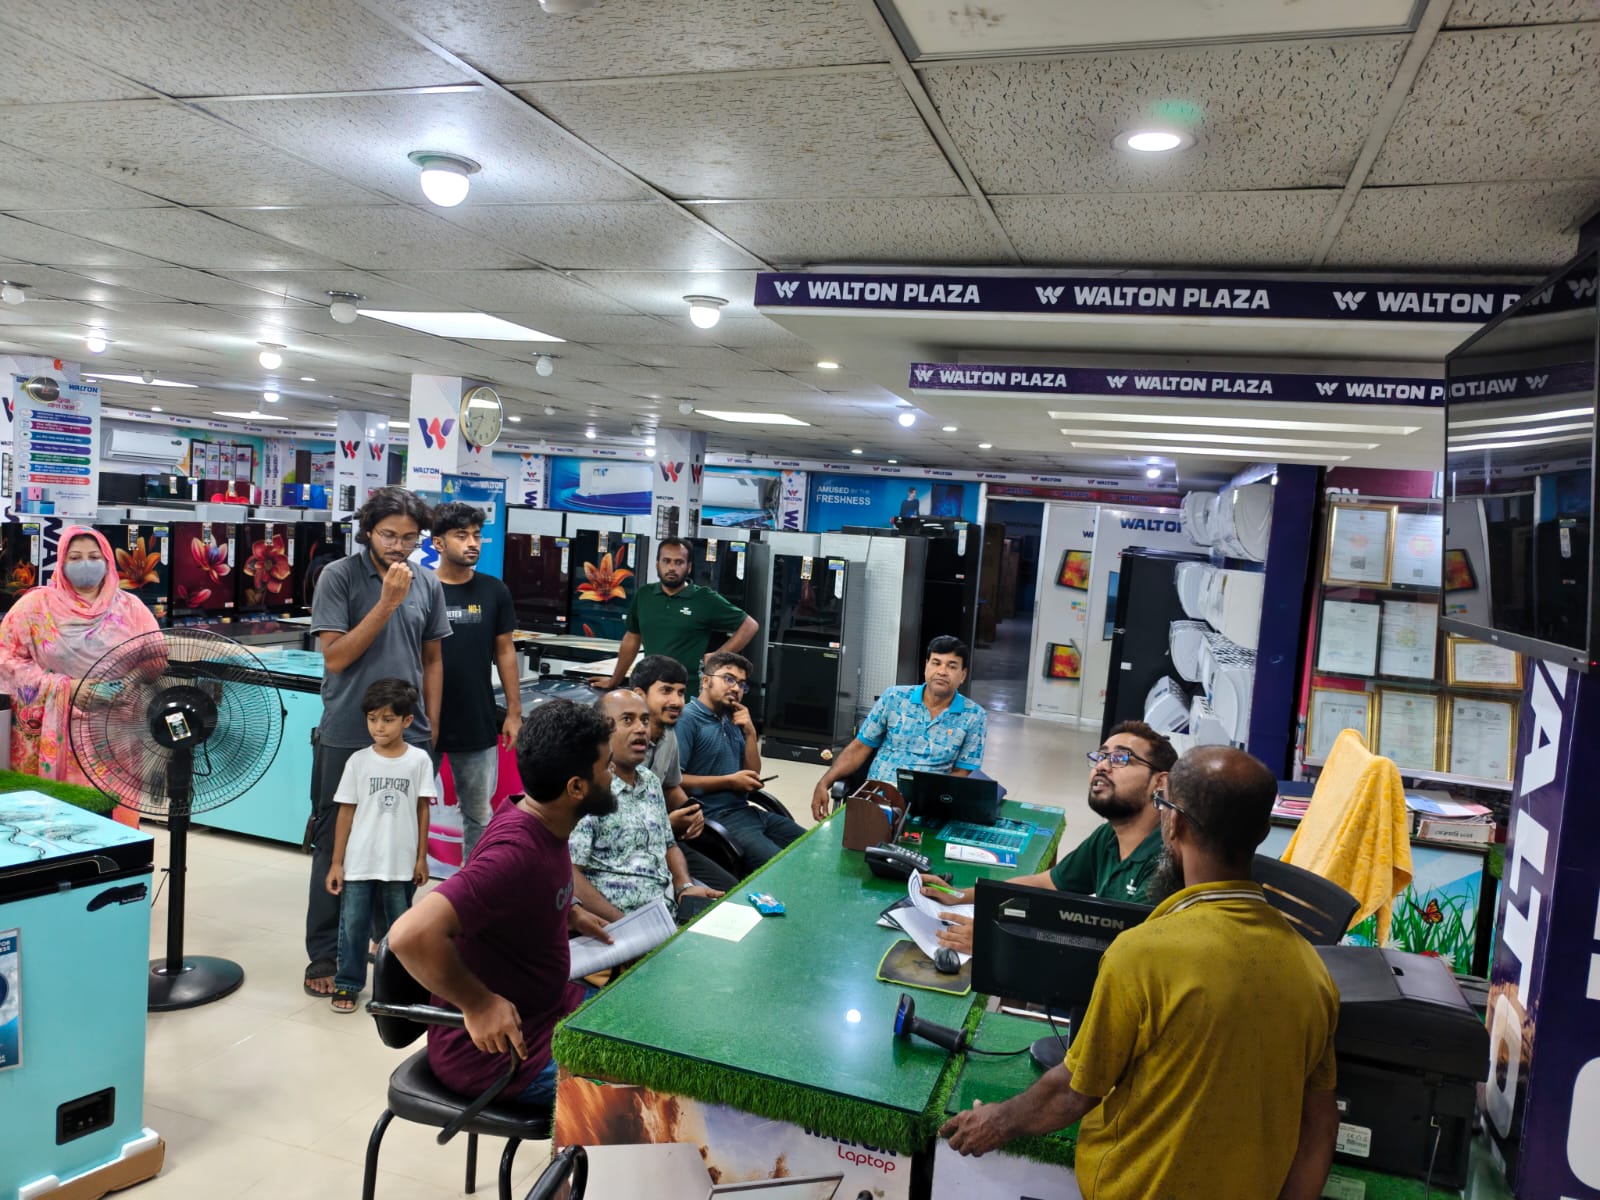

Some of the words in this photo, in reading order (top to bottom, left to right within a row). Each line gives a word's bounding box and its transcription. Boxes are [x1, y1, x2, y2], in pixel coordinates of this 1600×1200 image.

[808, 281, 898, 302] WALTON
[903, 283, 980, 303] PLAZA
[1074, 286, 1176, 307] WALTON
[1182, 288, 1270, 310] PLAZA
[1377, 292, 1494, 314] WALTON
[69, 383, 98, 394] WALTON
[940, 370, 1006, 386] WALTON
[1010, 372, 1067, 388] PLAZA
[1134, 375, 1206, 393] WALTON
[1211, 378, 1273, 395] PLAZA
[1346, 382, 1430, 400] WALTON
[413, 466, 440, 475] WALTON
[817, 485, 849, 494] AMUSED
[815, 494, 871, 506] FRESHNESS
[369, 777, 410, 798] HILFIGER
[1059, 910, 1125, 930] WALTON
[838, 1145, 896, 1174] Laptop
